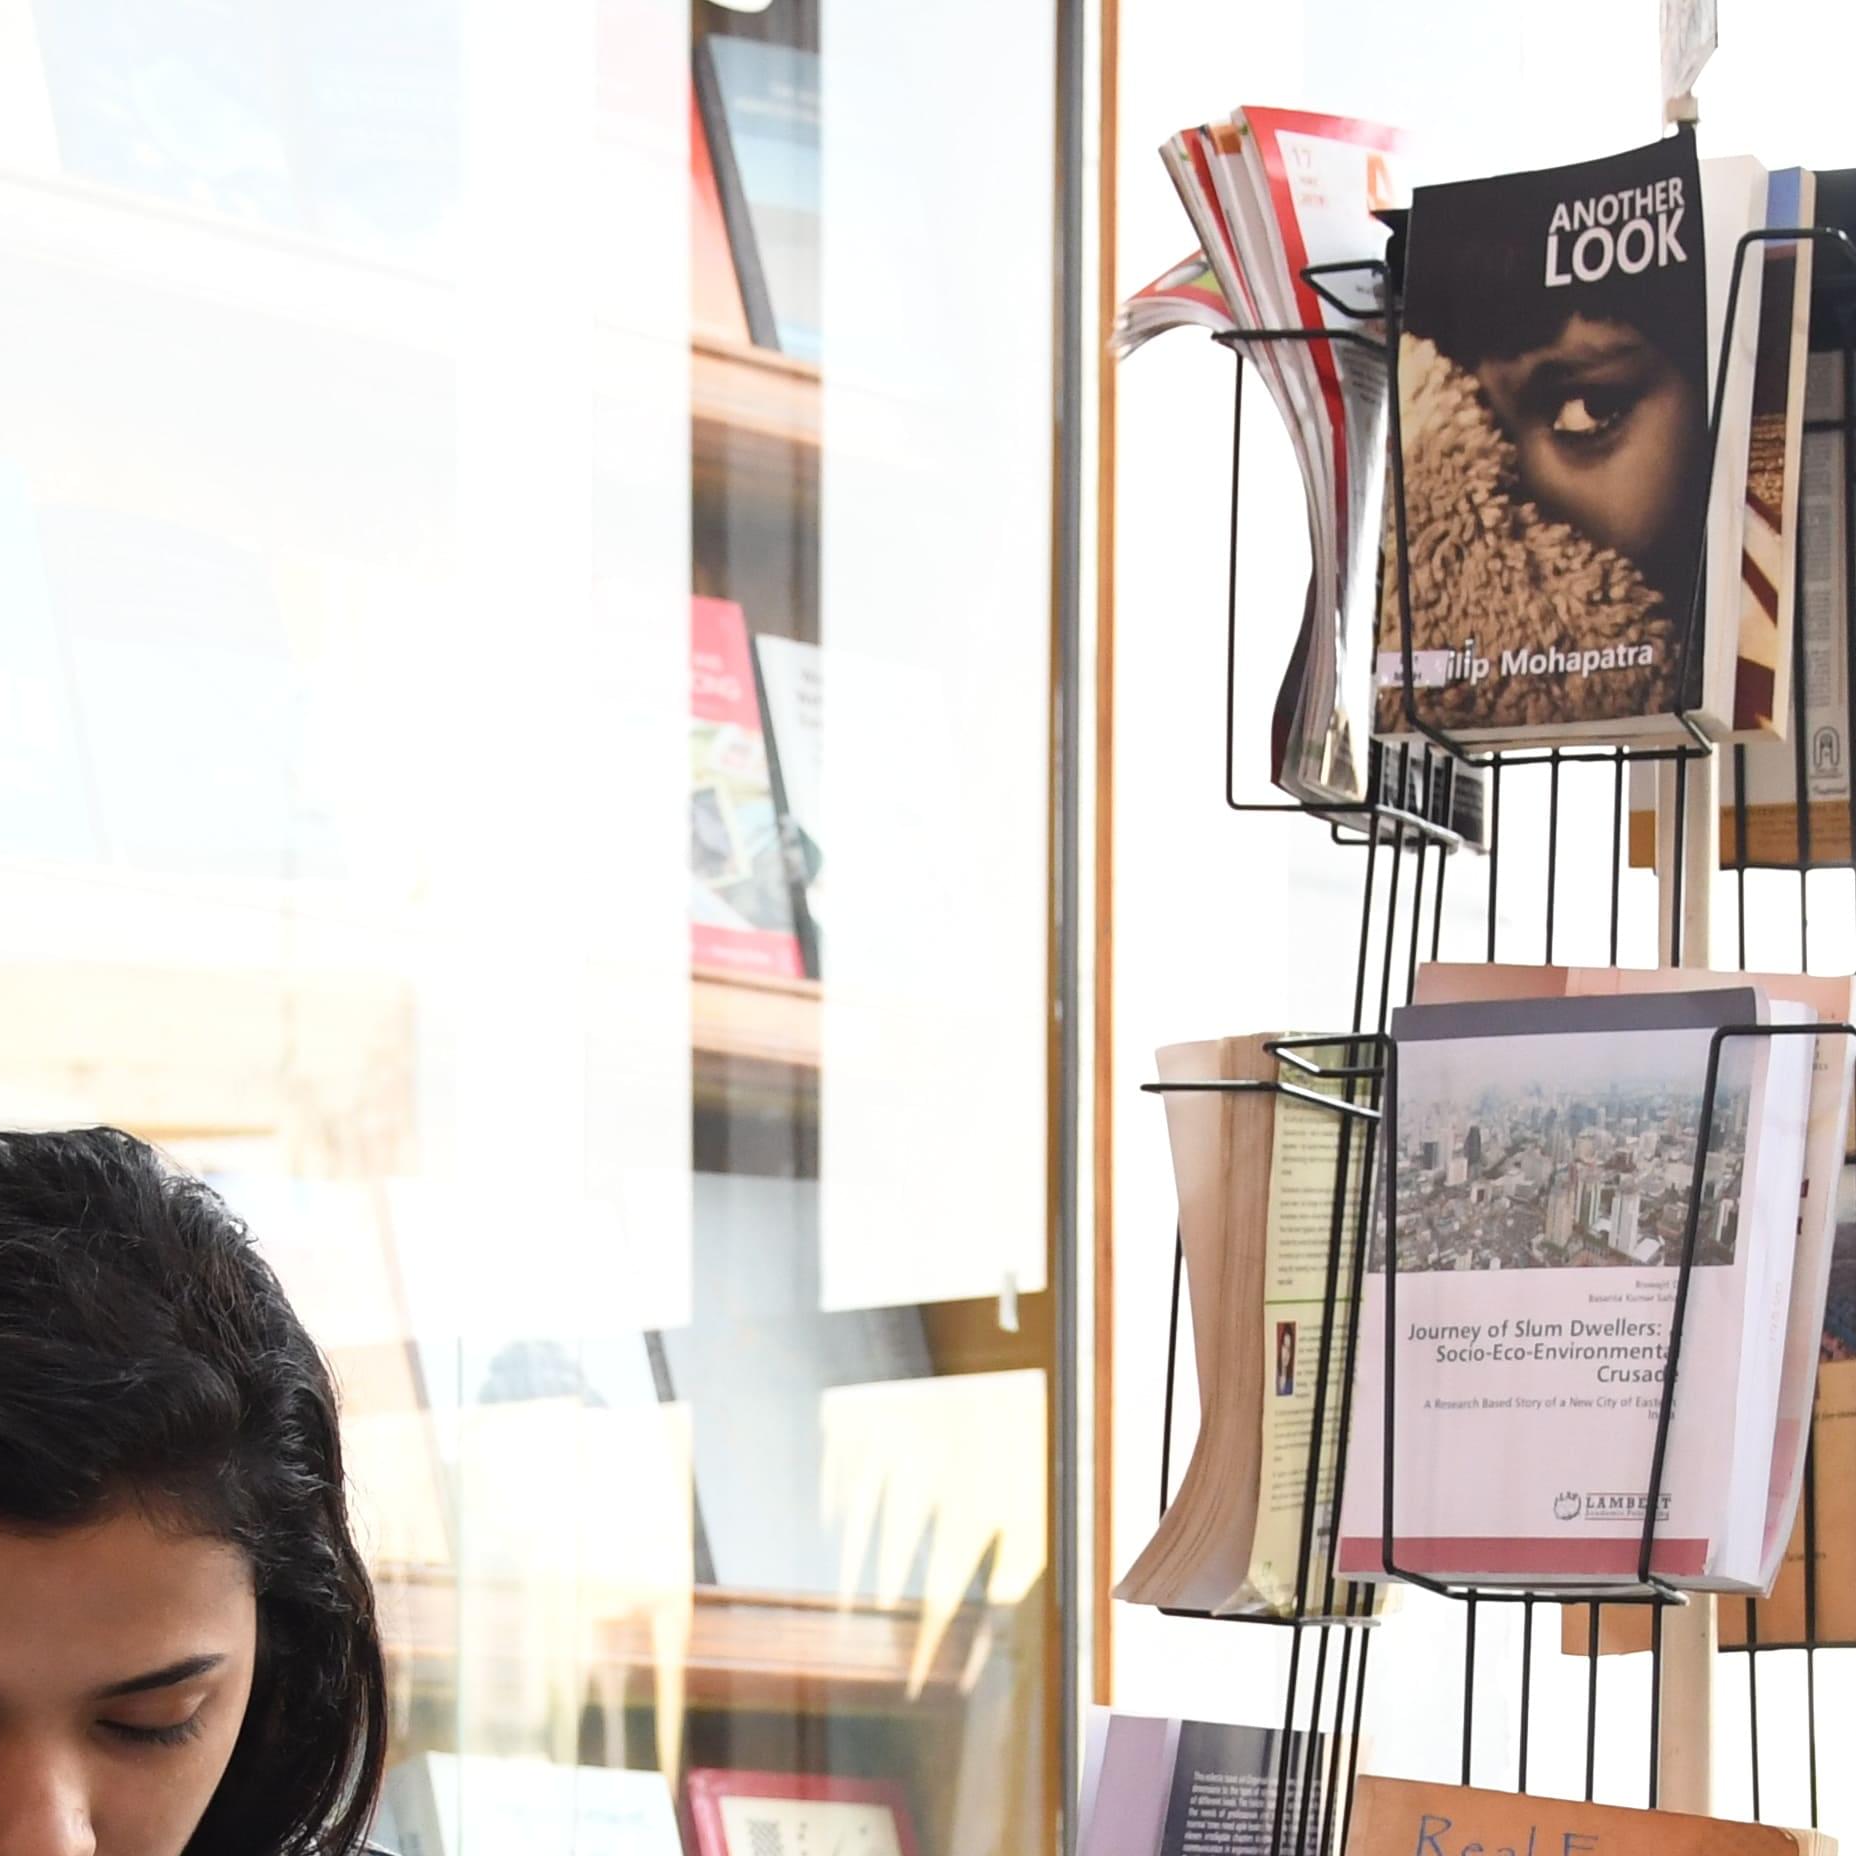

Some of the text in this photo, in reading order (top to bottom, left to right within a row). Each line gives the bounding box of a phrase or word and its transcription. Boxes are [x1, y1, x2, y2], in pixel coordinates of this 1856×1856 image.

[1549, 176, 1685, 234] ANOTHER
[1544, 208, 1688, 287] LOOK
[1445, 650, 1490, 686] ilip
[1501, 643, 1654, 680] Mohapatra
[1408, 1318, 1662, 1345] Journey of Slum Dwellers:
[1435, 1342, 1671, 1363] Socio-Eco-Environment
[1423, 1400, 1431, 1409] A
[1435, 1400, 1480, 1410] Research
[1482, 1399, 1512, 1409] Based
[1515, 1398, 1547, 1412] Story
[1548, 1397, 1557, 1409] of
[1560, 1399, 1566, 1408] a
[1569, 1397, 1593, 1408] New
[1596, 1397, 1617, 1410] City
[1620, 1397, 1633, 1408] of
[1586, 1496, 1671, 1509] LAMBET
